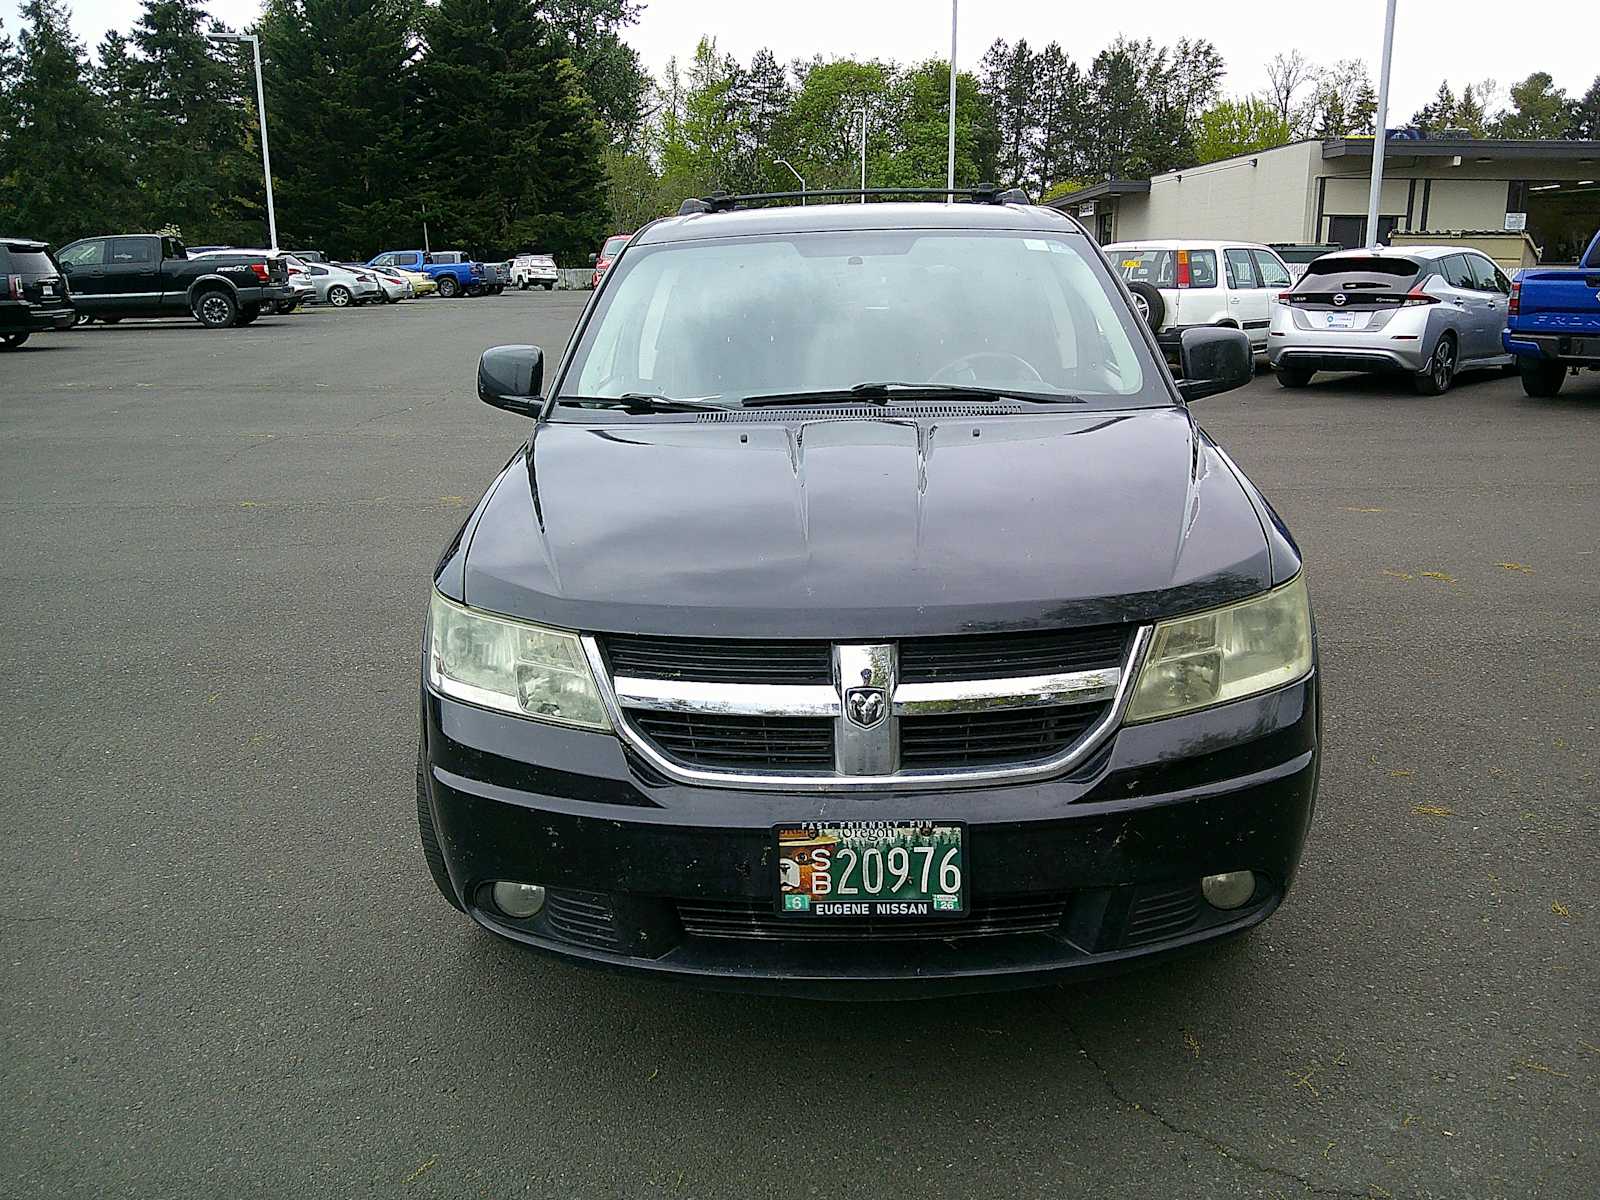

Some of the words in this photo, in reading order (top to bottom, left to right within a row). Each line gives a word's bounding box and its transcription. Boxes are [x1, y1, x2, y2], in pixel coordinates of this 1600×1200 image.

[843, 828, 895, 841] Oregon
[836, 846, 962, 894] 20976
[792, 896, 802, 909] 6
[816, 903, 870, 915] EUGENE
[876, 903, 928, 915] NISSAN
